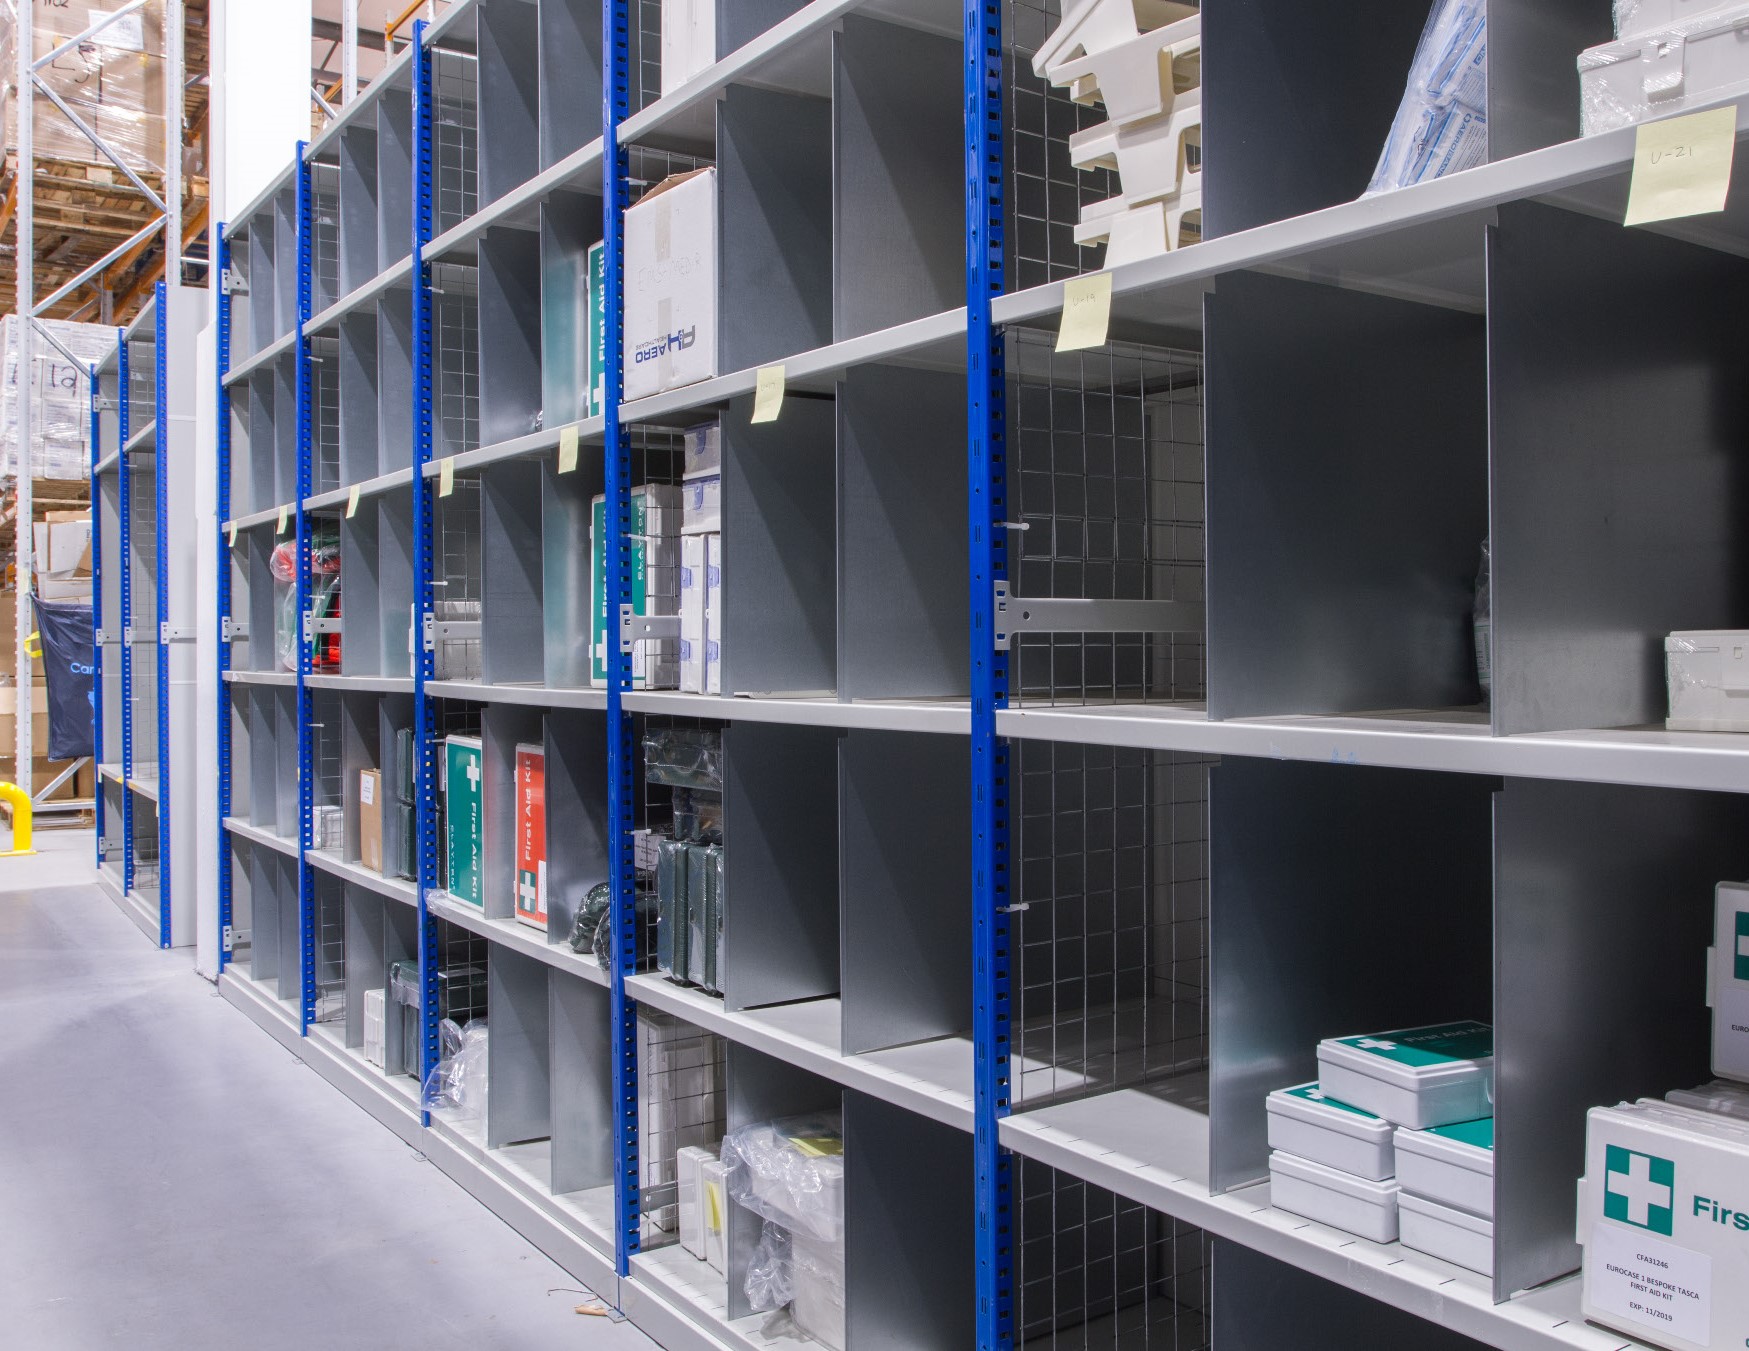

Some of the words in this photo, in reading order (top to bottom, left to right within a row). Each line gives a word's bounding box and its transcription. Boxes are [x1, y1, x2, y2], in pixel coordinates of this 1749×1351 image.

[1651, 146, 1692, 165] U-21
[635, 342, 667, 364] AERO
[1636, 1253, 1669, 1270] CFA31246
[1606, 1263, 1640, 1281] EUROCASE
[1646, 1276, 1676, 1293] BESPOKE
[1678, 1286, 1700, 1300] TASCA
[1630, 1281, 1648, 1293] FIRST
[1649, 1287, 1661, 1297] AID
[1662, 1292, 1673, 1301] KIT
[1629, 1301, 1644, 1312] EXP:
[1645, 1307, 1673, 1322] 11/2019
